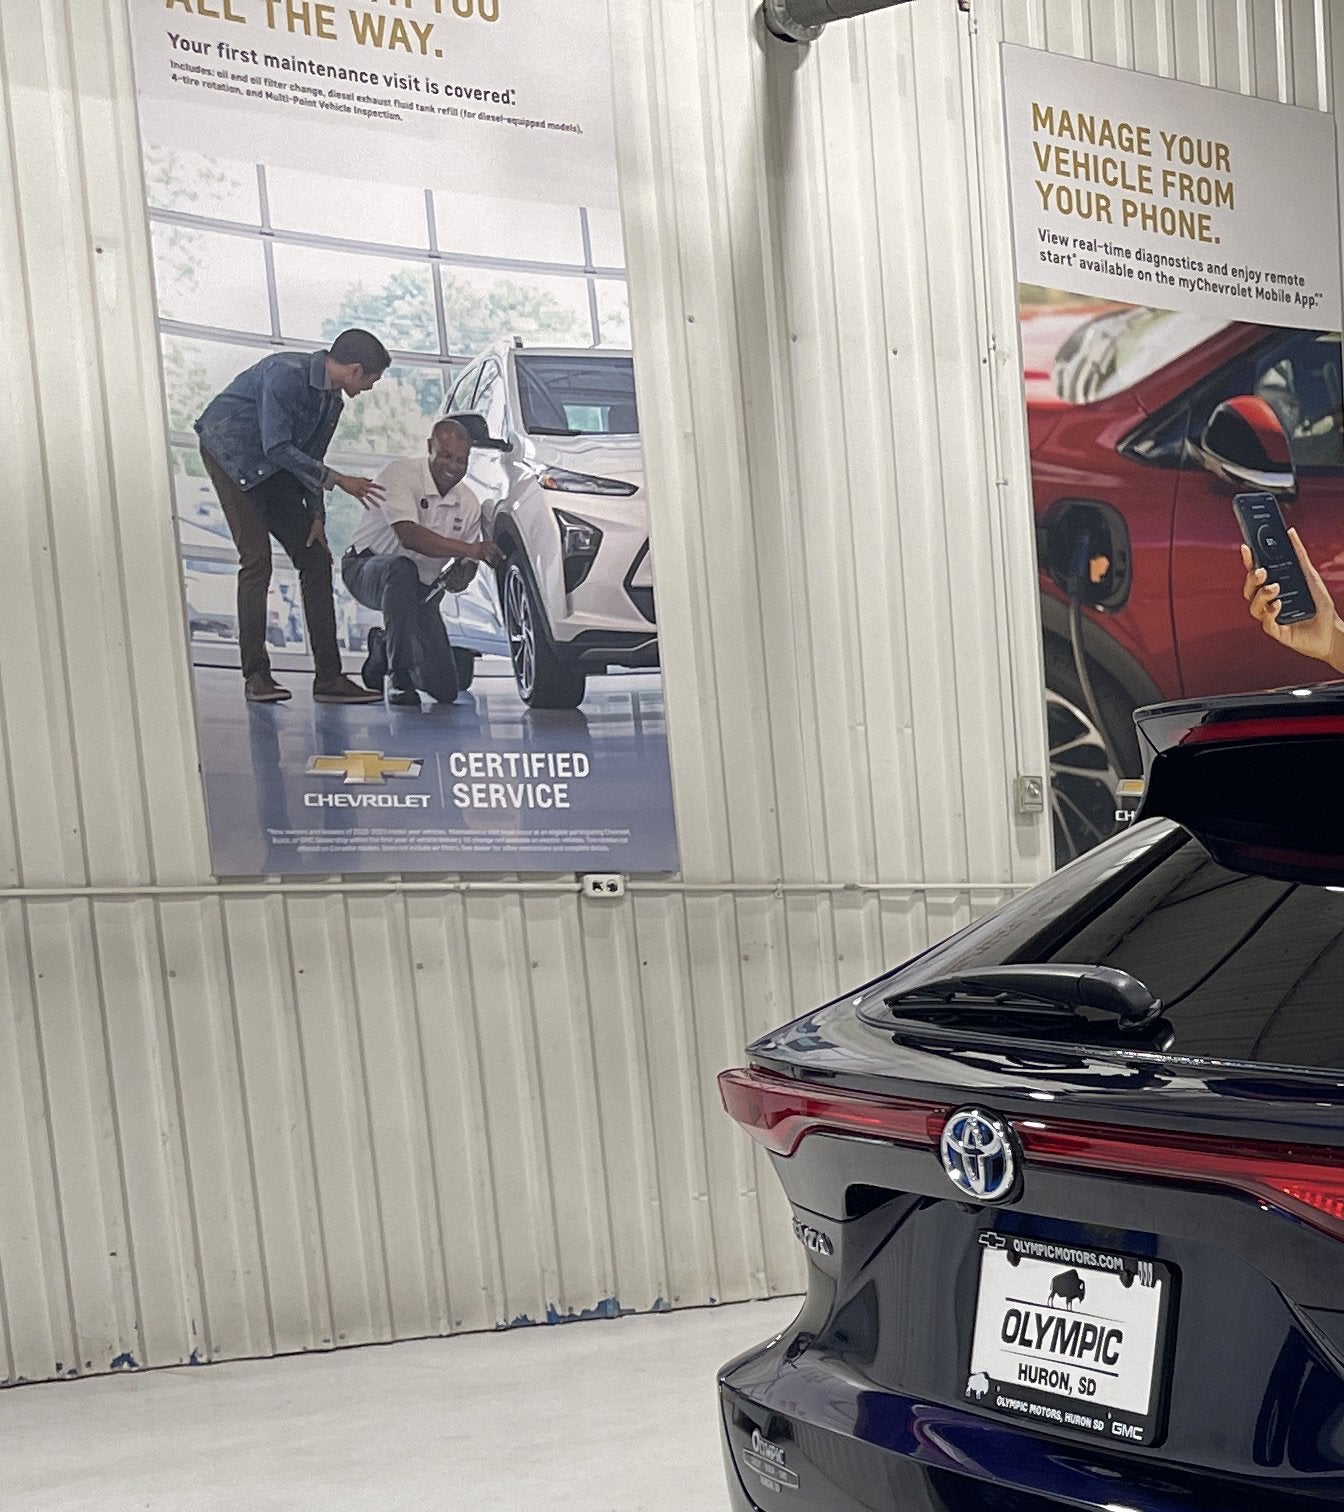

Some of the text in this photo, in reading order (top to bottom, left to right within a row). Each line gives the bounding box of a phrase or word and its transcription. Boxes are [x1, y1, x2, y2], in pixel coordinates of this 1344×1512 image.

[265, 0, 337, 40] THE
[348, 10, 443, 58] WAY.
[167, 31, 211, 55] Your
[217, 42, 259, 65] first
[264, 54, 379, 85] maintenance
[383, 73, 421, 92] visit
[425, 78, 439, 95] is
[170, 59, 215, 77] Includes:
[230, 71, 249, 83] and
[264, 78, 287, 89] filter
[328, 89, 355, 102] diesel
[416, 103, 435, 114] tank
[171, 73, 200, 87] 4-tire
[202, 81, 244, 96] rotation,
[246, 88, 263, 99] and
[318, 99, 351, 114] Vehicle
[1031, 102, 1232, 173] MANAGE YOUR
[1032, 141, 1235, 211] VEHICLE FROM
[1034, 180, 1221, 245] YOUR PHONE.
[1038, 227, 1305, 287] View real-time diagnostics and enjoy remote
[1080, 258, 1134, 279] available
[1137, 270, 1152, 282] on
[1155, 270, 1175, 286] the
[1179, 276, 1253, 299] myChevrolet
[1255, 286, 1292, 304] Mobile
[449, 751, 590, 779] CERTIFIED
[303, 793, 431, 808] CHEVROLET
[453, 783, 571, 809] SERVICE
[1013, 1238, 1124, 1271] OLYMPICMOTORS.COM
[1000, 1308, 1124, 1366] OLYMPIC
[1018, 1363, 1097, 1397] HURON, SD
[996, 1396, 1105, 1432] OLYMPIC MOTORS, HURON SD
[1111, 1421, 1144, 1441] GMC
